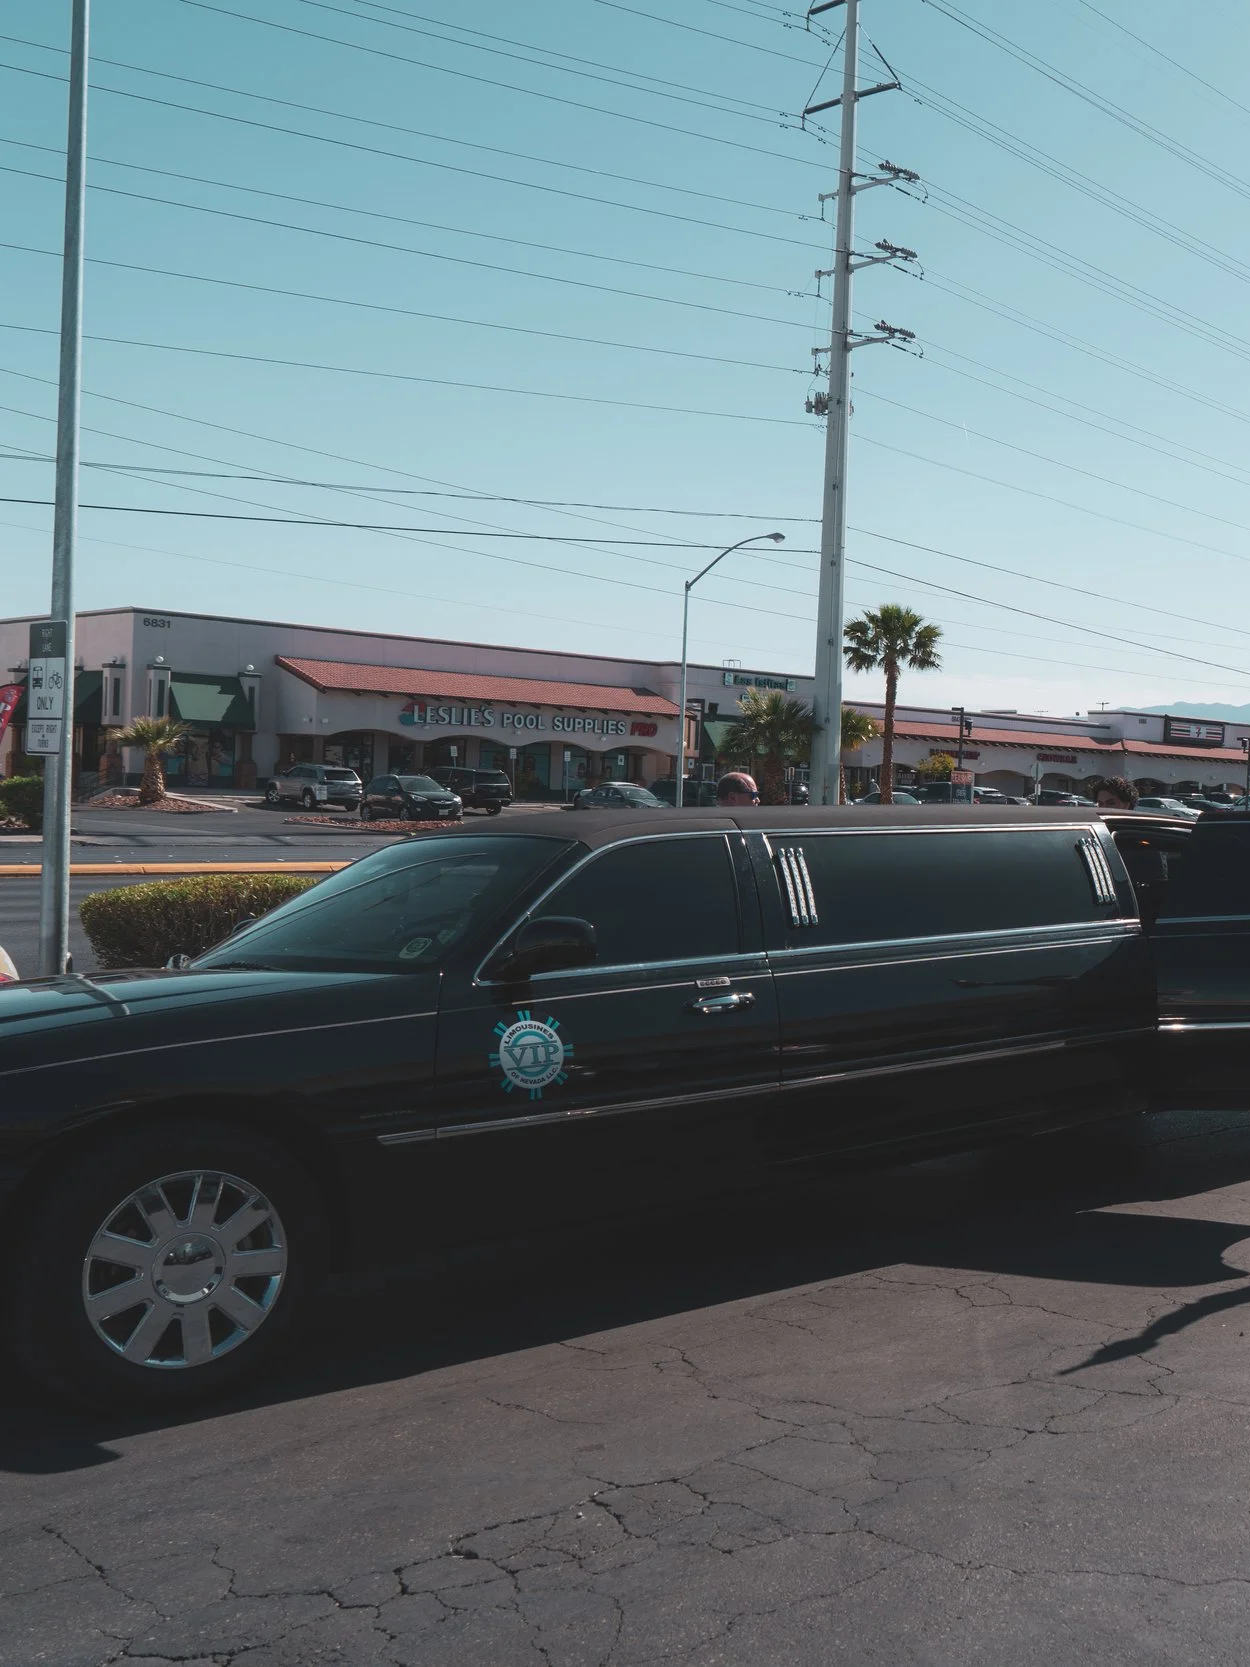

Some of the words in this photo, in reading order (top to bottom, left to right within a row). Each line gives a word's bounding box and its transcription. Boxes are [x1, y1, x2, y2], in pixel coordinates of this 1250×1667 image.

[143, 617, 171, 629] 6831
[36, 696, 54, 711] ONLY
[412, 704, 496, 728] LESLIE'S
[502, 713, 545, 730] POOL
[552, 716, 627, 736] SUPPLIES
[630, 722, 659, 738] PRO
[504, 1024, 554, 1045] LIMOUSINES
[504, 1044, 559, 1067] VIP
[511, 1071, 520, 1080] OF
[520, 1077, 546, 1085] NEVADA
